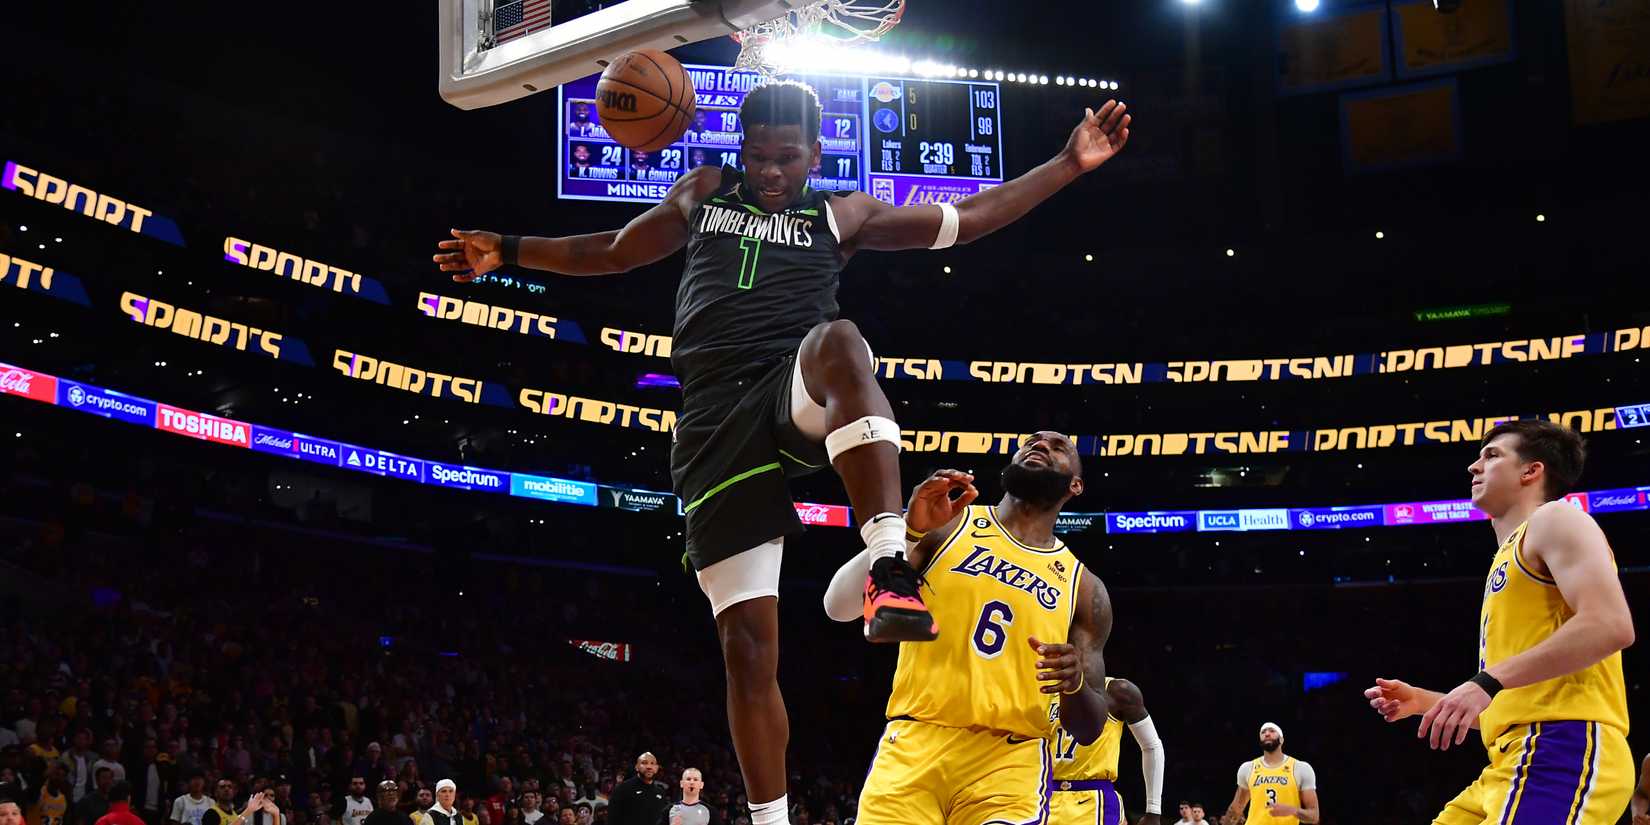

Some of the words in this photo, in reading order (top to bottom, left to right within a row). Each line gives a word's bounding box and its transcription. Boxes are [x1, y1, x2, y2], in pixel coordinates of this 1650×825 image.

[696, 94, 738, 105] ELES
[974, 90, 995, 109] 103
[720, 112, 737, 132] 19
[834, 119, 851, 139] 12
[910, 114, 917, 130] 0
[977, 117, 993, 135] 98
[601, 145, 622, 166] 24
[660, 149, 681, 169] 23
[919, 141, 954, 165] 2:39
[588, 168, 618, 180] TOWNS
[837, 158, 851, 178] 11
[607, 183, 673, 198] MINNES
[700, 204, 813, 248] TIMBERWOLVES
[737, 236, 762, 290] 1
[86, 393, 147, 417] crypto.com
[160, 408, 247, 444] TOSHIBA
[1628, 414, 1638, 425] 2
[861, 429, 881, 441] AE
[300, 441, 337, 459] ULTRA
[364, 453, 418, 477] DELTA
[431, 464, 499, 487] Spectrum
[523, 479, 586, 497] mobilitie
[1452, 502, 1473, 511] TASTE
[976, 519, 987, 528] 6
[1116, 514, 1184, 530] Spectrum
[1207, 515, 1236, 527] UCLA
[1242, 512, 1285, 527] Health
[1314, 510, 1375, 526] crypto.com
[951, 545, 1061, 611] LAKERS
[972, 600, 1014, 659] 6
[1253, 774, 1289, 787] LAKERS
[1265, 788, 1278, 807] 3
